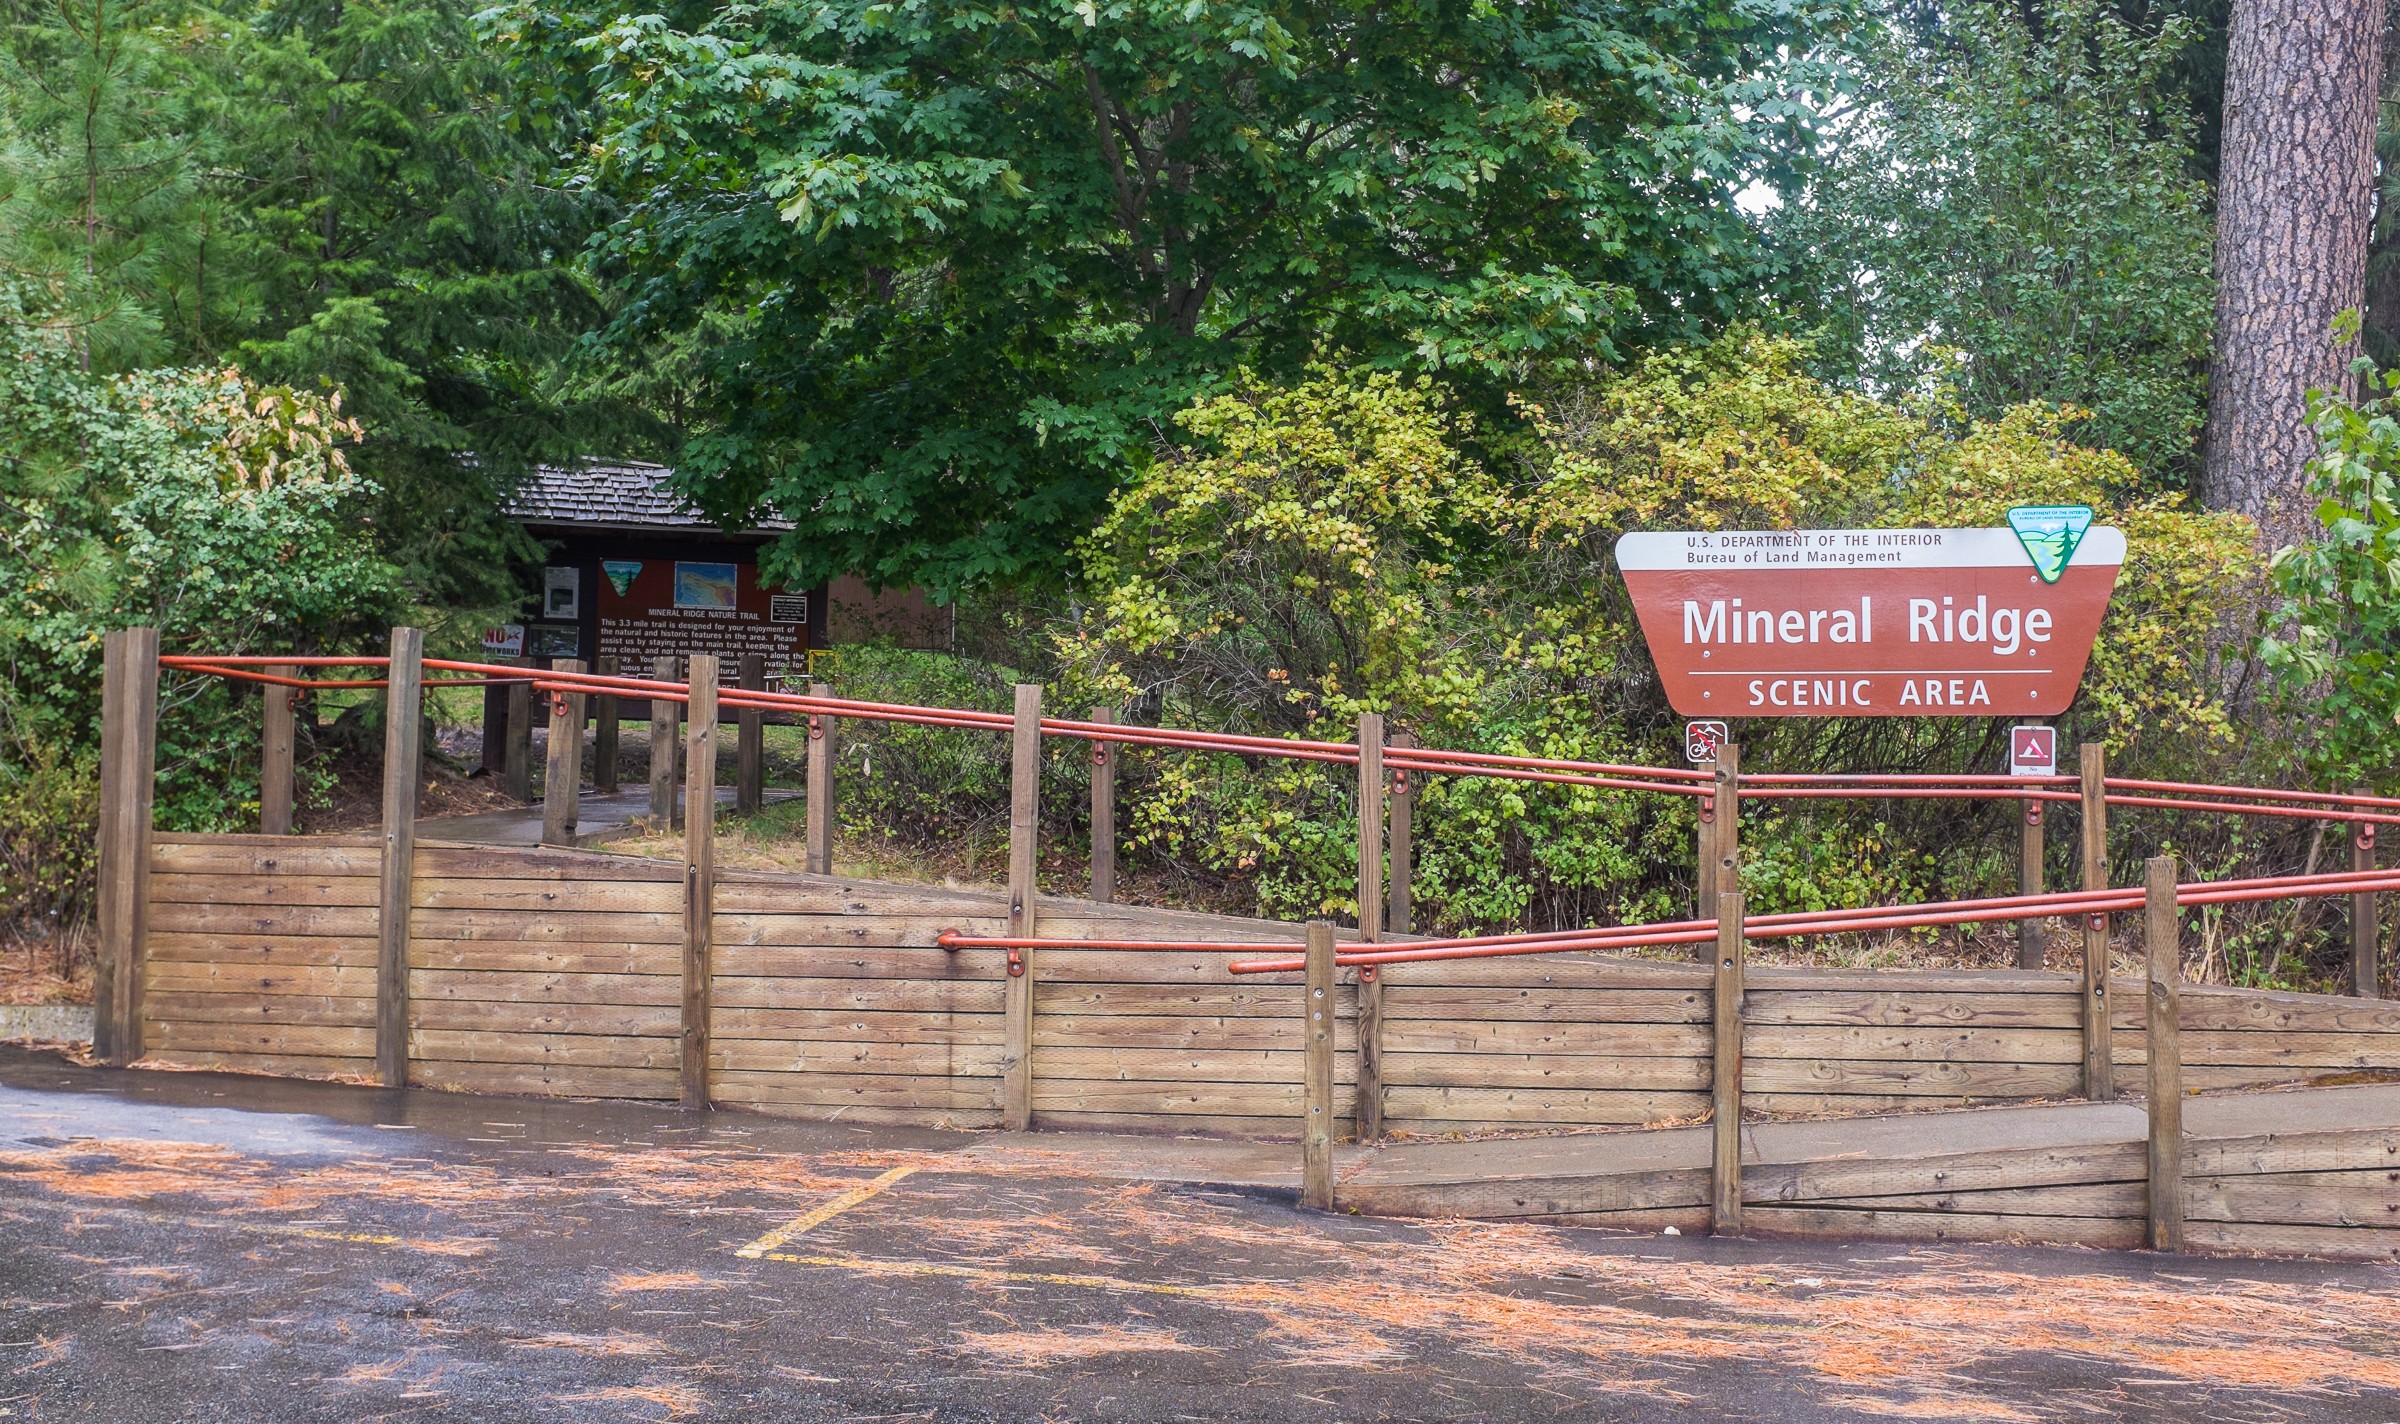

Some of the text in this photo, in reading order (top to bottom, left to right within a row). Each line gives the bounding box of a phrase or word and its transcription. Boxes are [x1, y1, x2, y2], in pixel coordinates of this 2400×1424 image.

[1688, 534, 1942, 548] U.S. DEPARTMENT OF THE INTERIOR
[1687, 551, 1902, 565] Bureau of Land Management
[648, 608, 680, 616] MINERAL
[708, 611, 736, 619] NATURE
[678, 622, 711, 630] designed
[747, 625, 784, 633] enjoyment
[1683, 595, 2052, 655] Mineral Ridge
[615, 628, 641, 636] natural
[692, 631, 722, 639] features
[774, 634, 797, 642] Please
[637, 638, 646, 646] by
[649, 639, 676, 647] staying
[746, 643, 774, 651] keeping
[770, 652, 790, 660] along
[1748, 679, 1991, 706] SCENIC AREA
